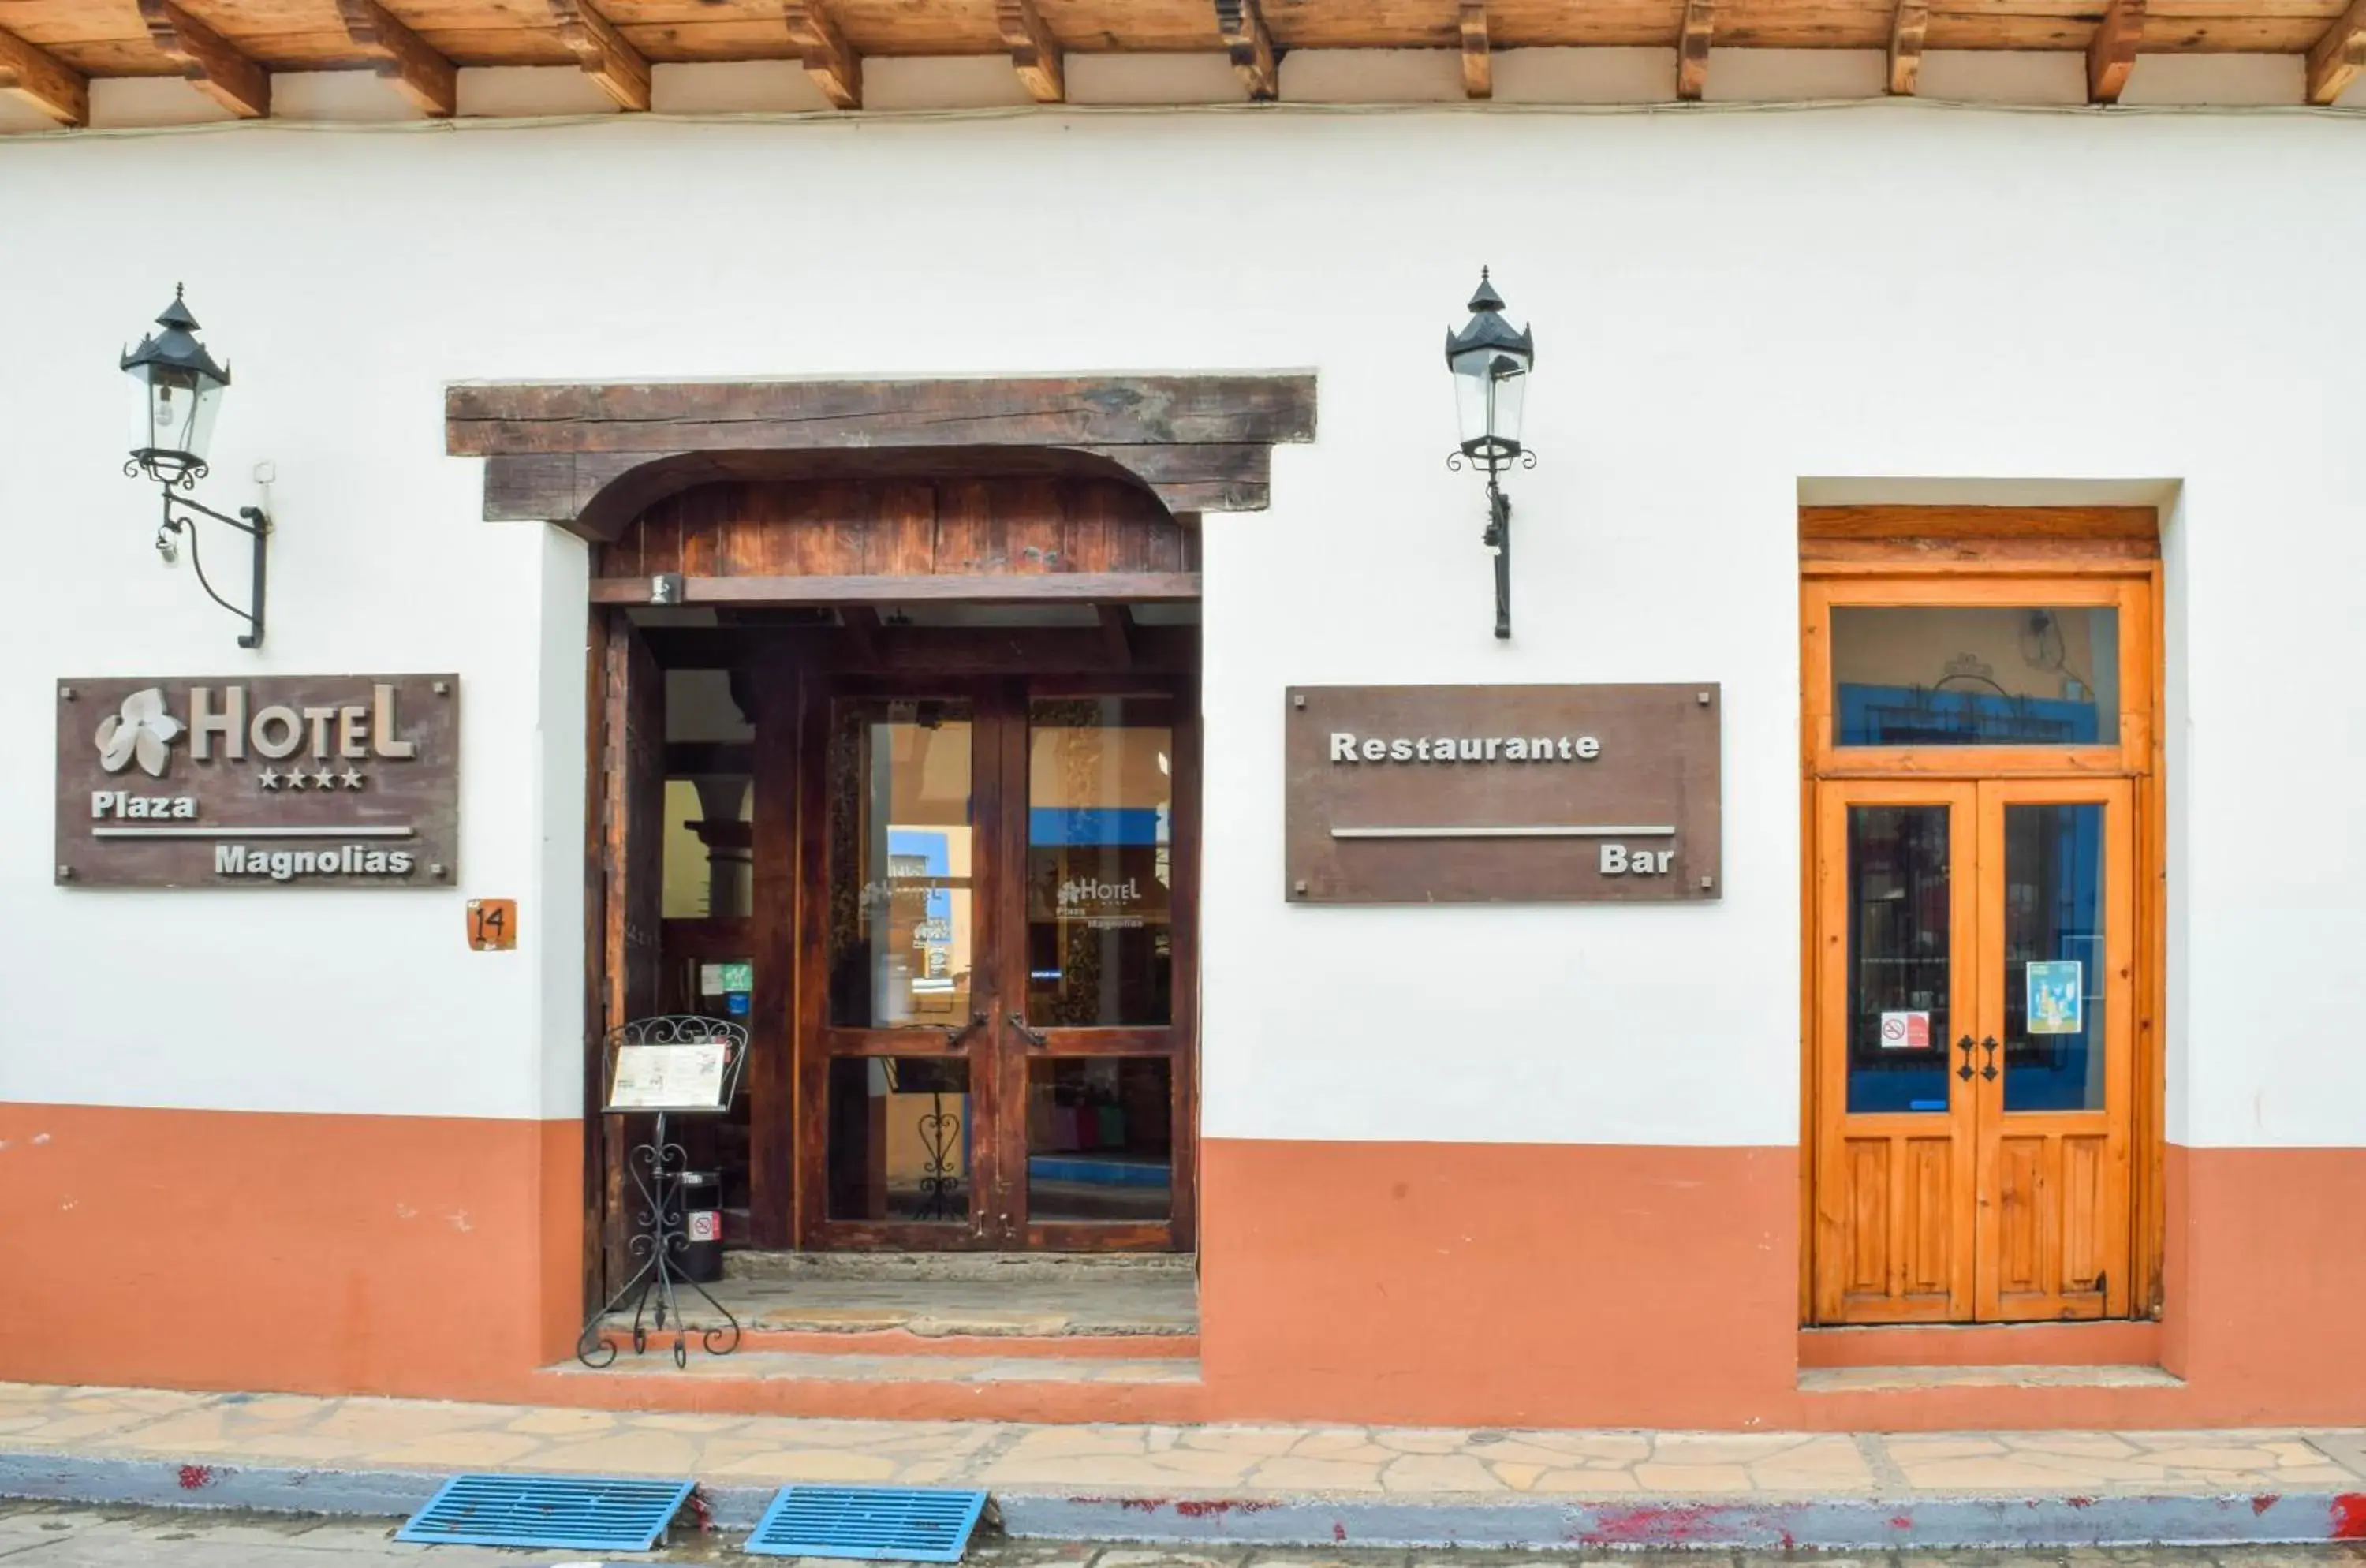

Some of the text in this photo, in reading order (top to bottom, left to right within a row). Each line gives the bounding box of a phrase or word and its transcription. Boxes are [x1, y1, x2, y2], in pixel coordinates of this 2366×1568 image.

[190, 684, 416, 760] HOTEL
[1330, 732, 1600, 761] Restaurante
[91, 791, 196, 819] Plaza
[215, 845, 412, 880] Magnolias
[1599, 844, 1674, 875] Bar
[1081, 877, 1141, 899] HOTEL
[476, 907, 505, 942] 14
